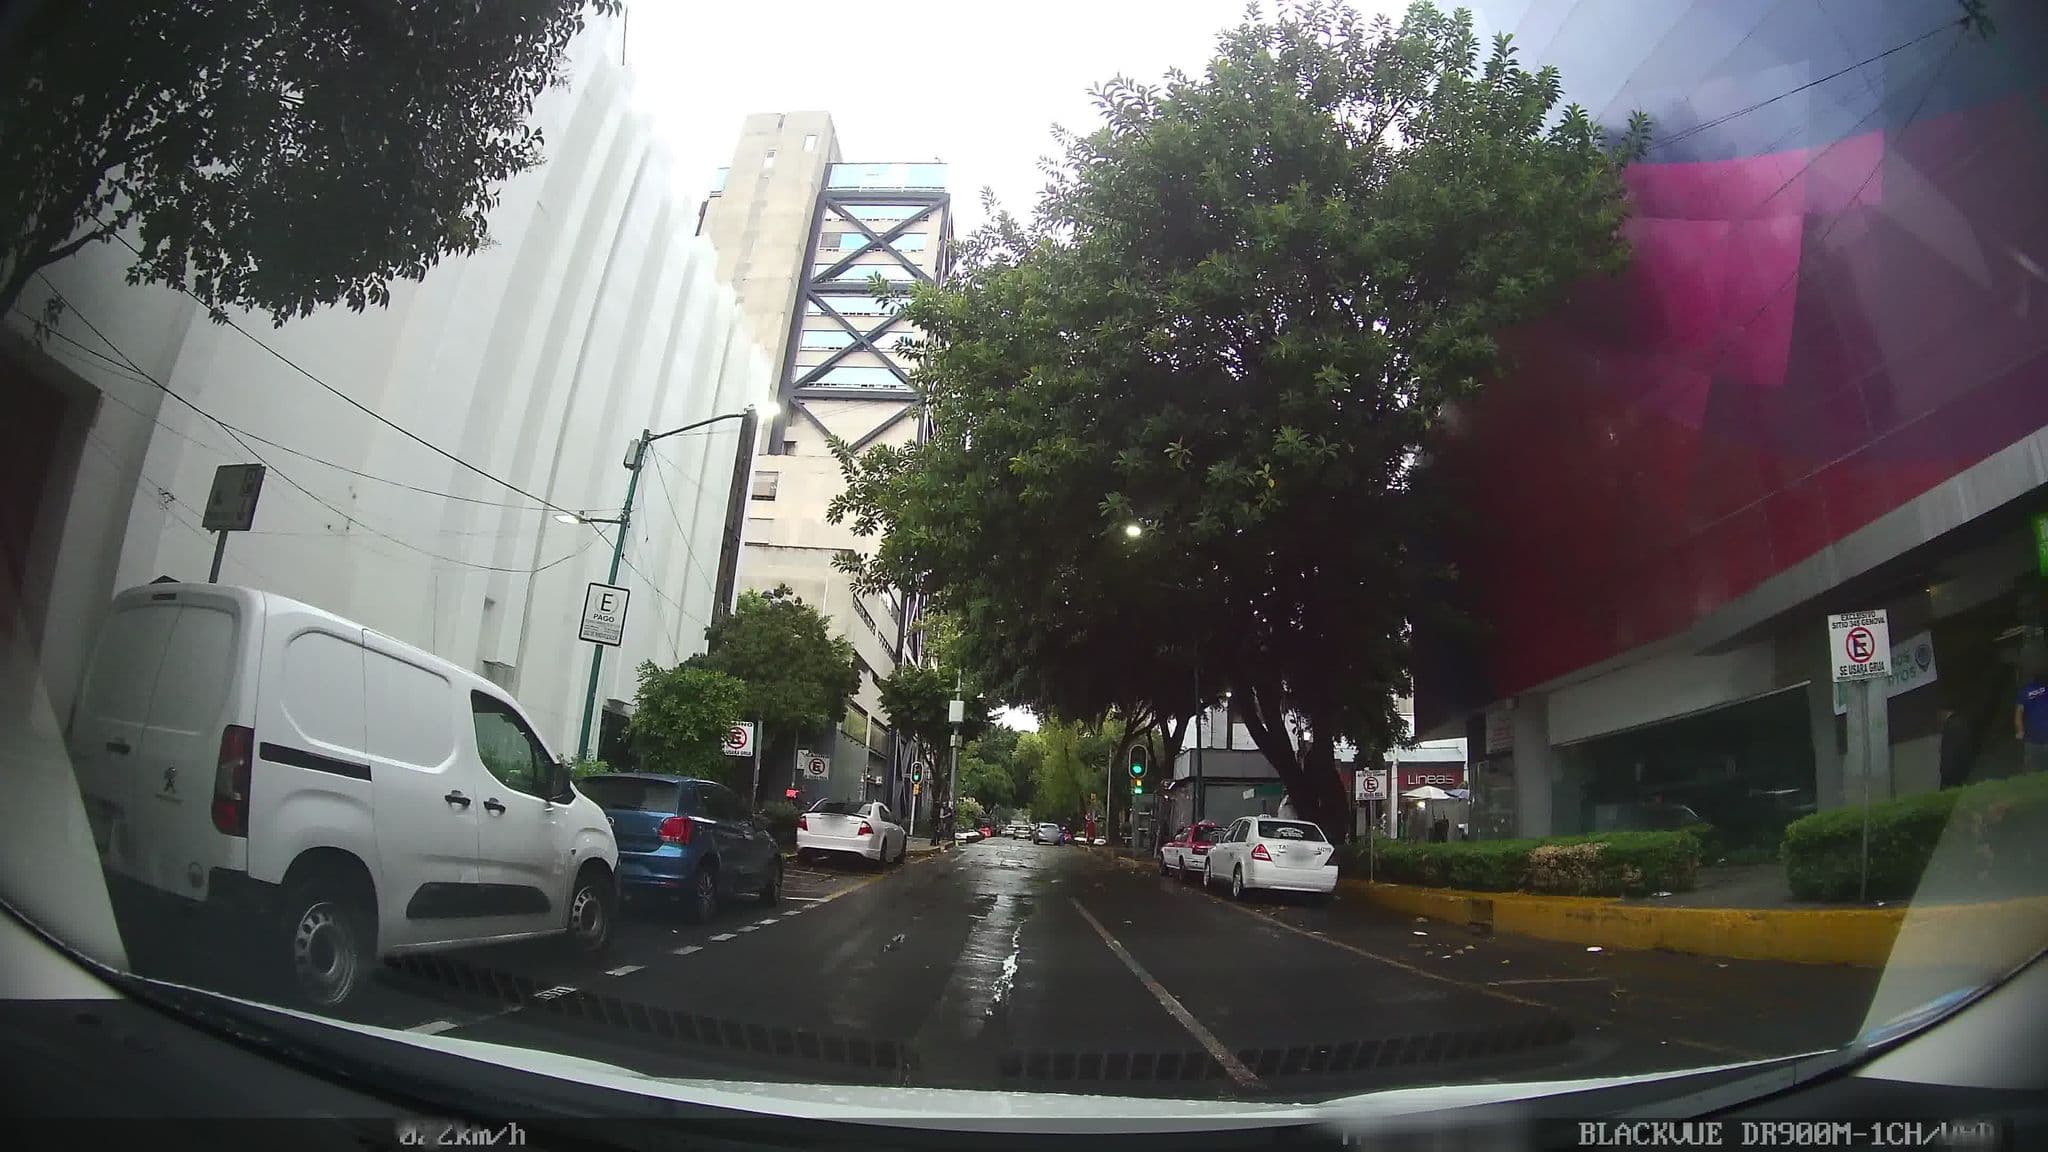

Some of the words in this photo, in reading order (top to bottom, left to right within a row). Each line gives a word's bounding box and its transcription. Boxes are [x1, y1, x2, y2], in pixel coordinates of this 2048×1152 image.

[600, 593, 614, 612] E
[593, 613, 615, 623] PAGO
[1841, 611, 1876, 621] EXCLUSIVO
[1832, 621, 1848, 629] SITIO
[1852, 633, 1867, 658] E
[1840, 665, 1848, 676] SE
[1848, 664, 1868, 675] USARA
[1869, 661, 1885, 672] GRUA
